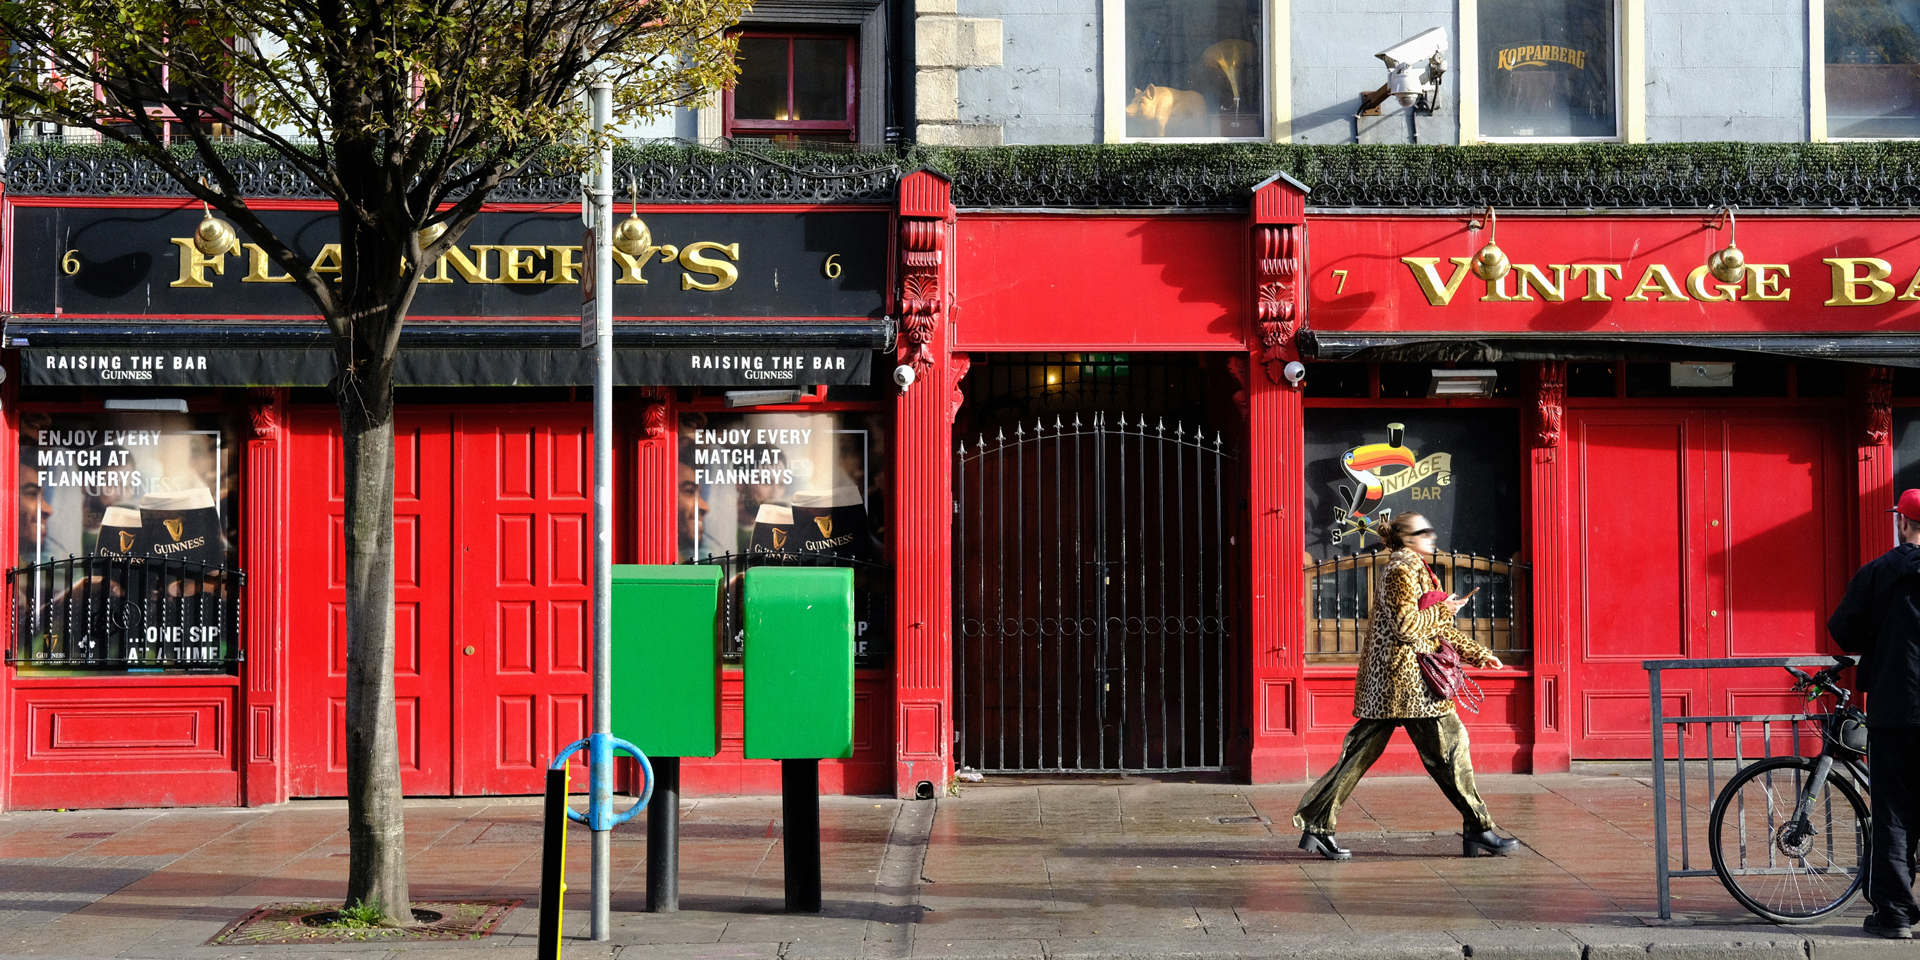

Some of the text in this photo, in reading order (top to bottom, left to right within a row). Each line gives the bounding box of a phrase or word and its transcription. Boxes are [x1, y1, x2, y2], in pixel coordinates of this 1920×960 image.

[1498, 45, 1585, 71] KOPPARBERG
[62, 248, 81, 276] 6
[170, 237, 740, 292] FLANERY'S
[824, 253, 842, 280] 6
[1331, 270, 1348, 295] 7
[1401, 256, 1791, 306] VINTAGE
[46, 355, 208, 370] RAISING THE BAR
[691, 355, 846, 370] RAISING THE BAR
[101, 369, 153, 380] GUINNESS
[744, 369, 794, 380] GUINNESS
[38, 430, 162, 446] ENJOY EVERY
[695, 429, 812, 445] ENJOY EVERY
[38, 450, 130, 467] MATCH AT
[695, 449, 782, 465] MATCH AT
[37, 470, 142, 487] FLANNERYS
[695, 469, 793, 485] FLANNERYS
[1411, 486, 1442, 500] BAR
[1334, 507, 1346, 523] W
[805, 533, 854, 551] GUINNESS
[1332, 529, 1342, 543] S
[154, 536, 205, 555] GUINNESS
[189, 626, 218, 643] SIP
[174, 647, 219, 663] TIME
